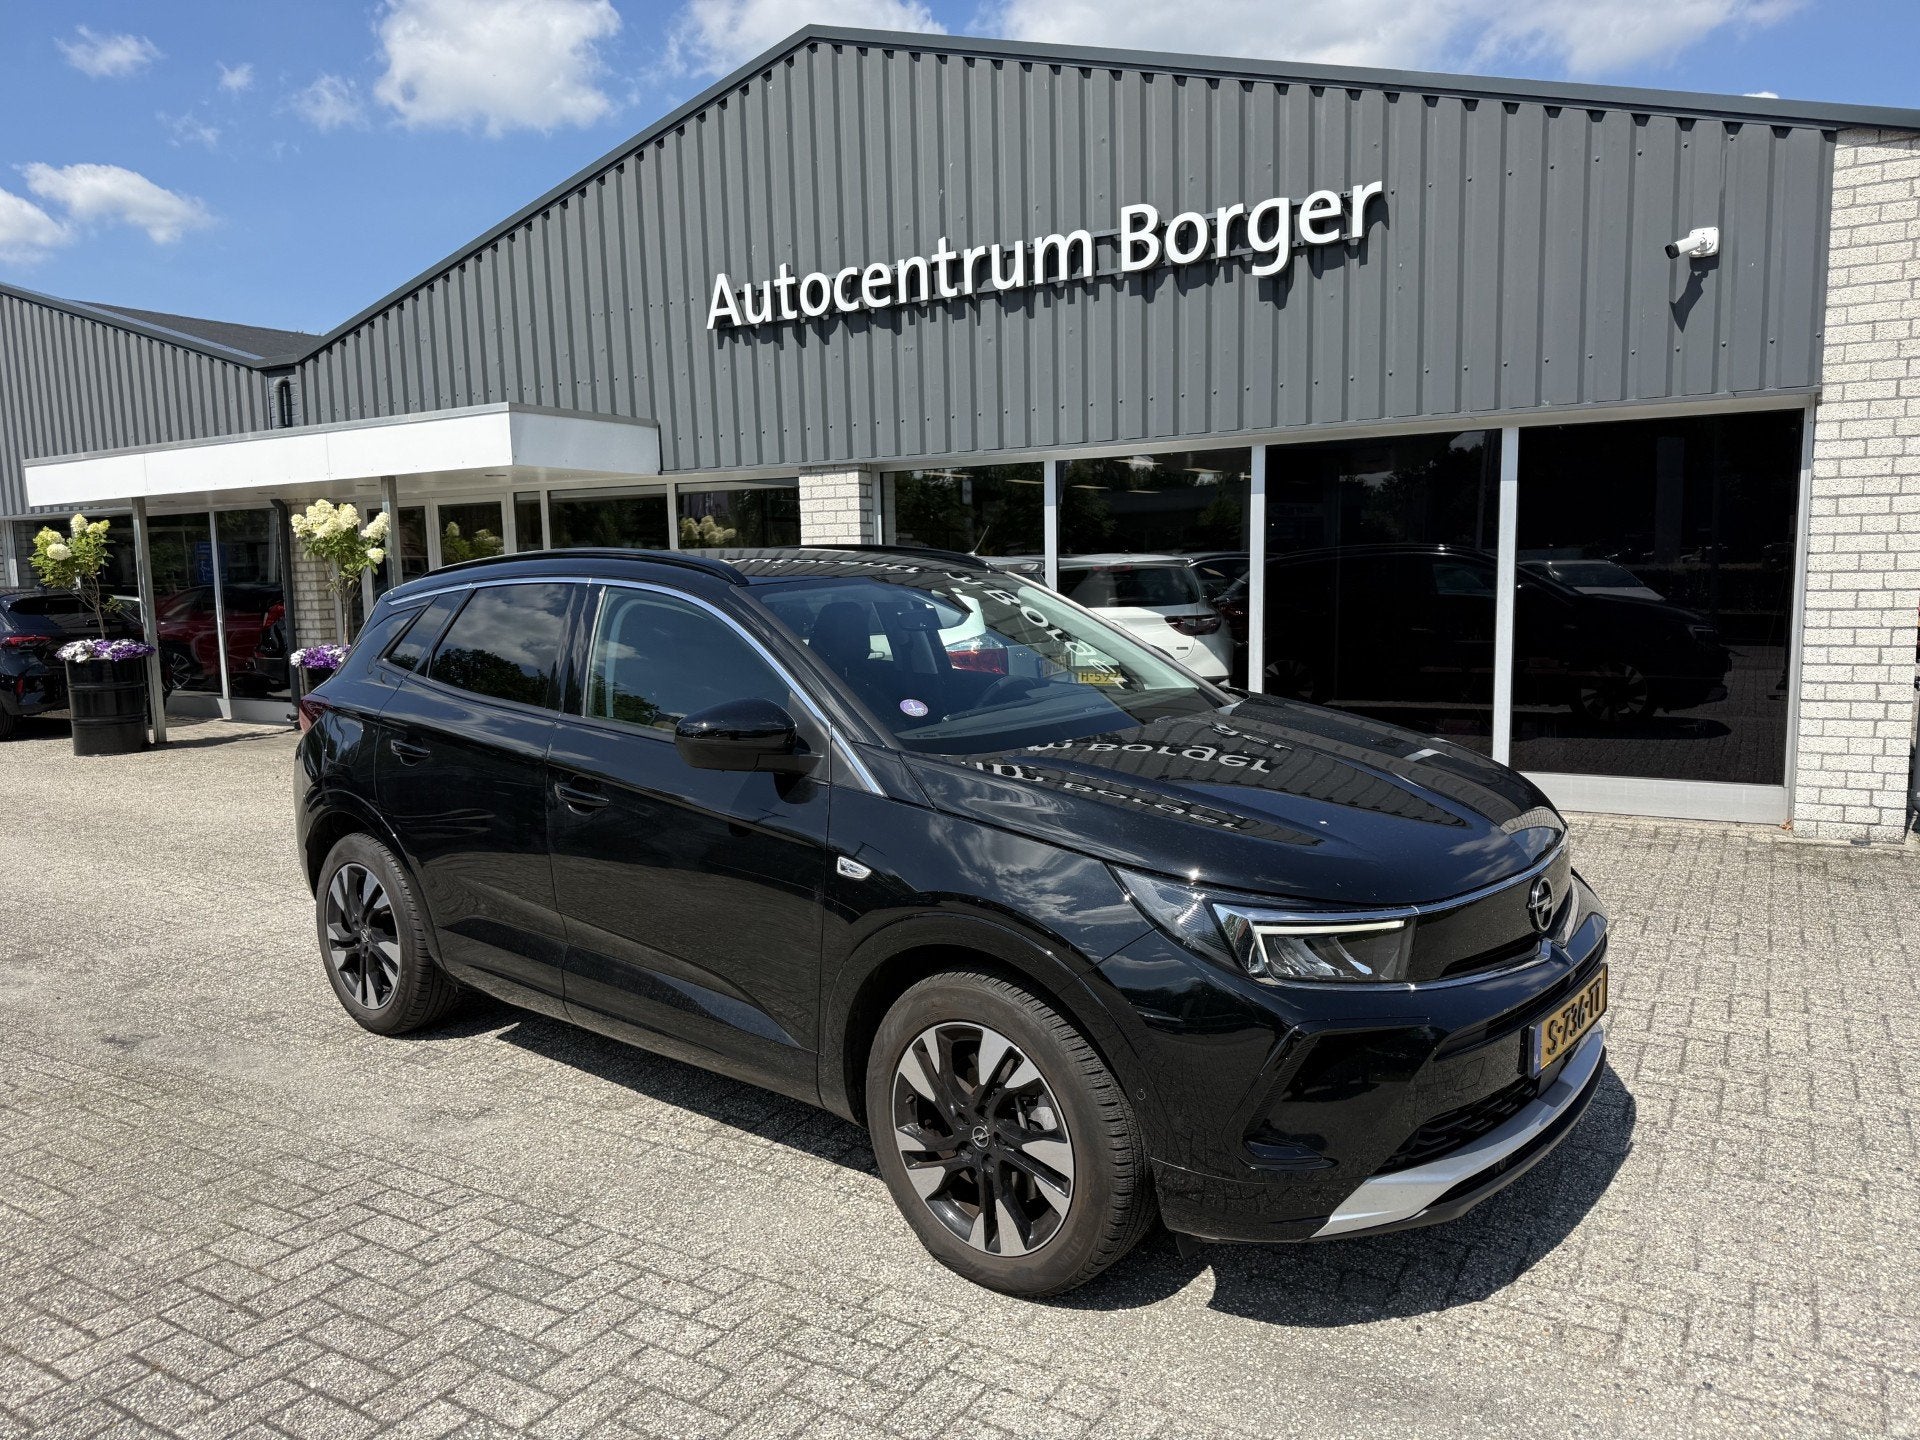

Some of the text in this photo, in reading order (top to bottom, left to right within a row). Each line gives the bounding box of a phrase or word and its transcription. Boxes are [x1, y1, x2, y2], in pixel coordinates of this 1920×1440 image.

[706, 180, 1383, 330] Autocentrum Borger
[1546, 977, 1602, 1055] S-736-TT
